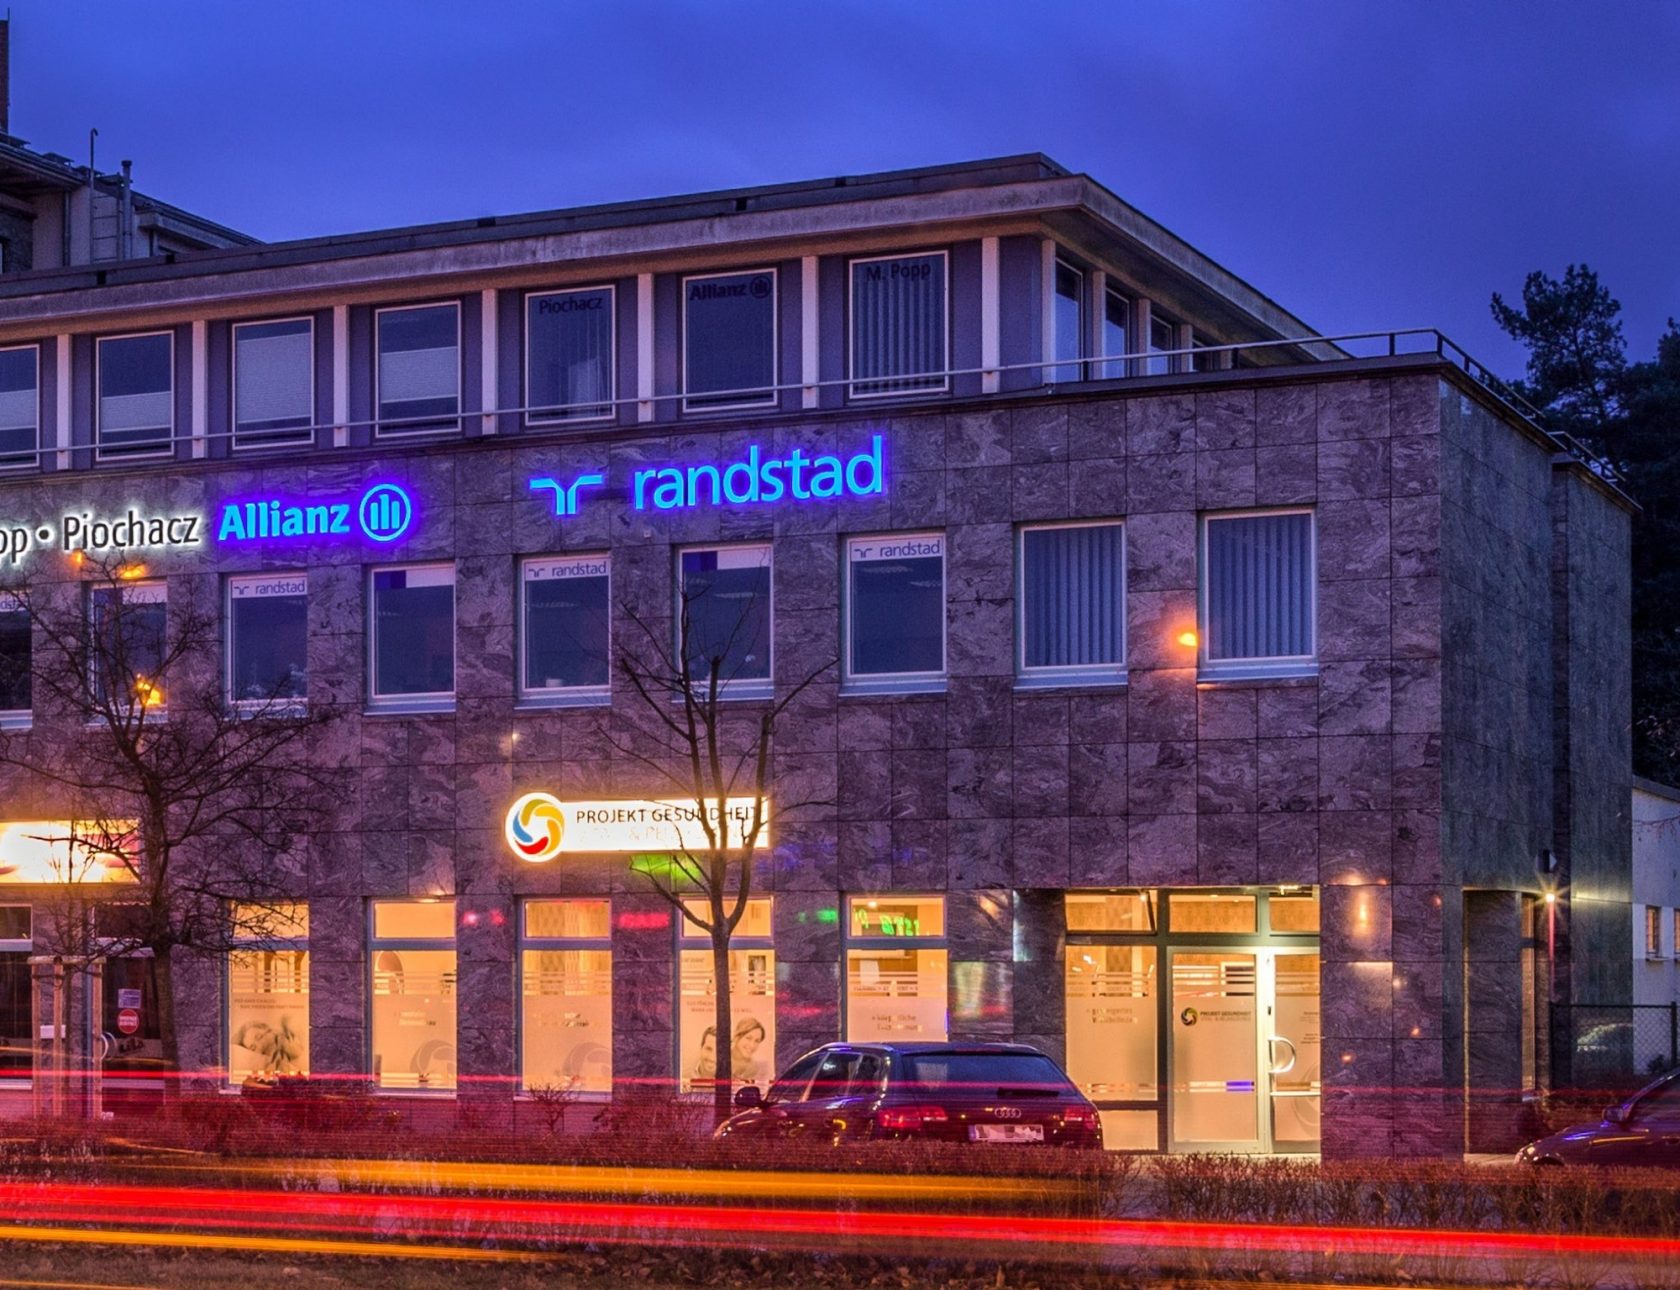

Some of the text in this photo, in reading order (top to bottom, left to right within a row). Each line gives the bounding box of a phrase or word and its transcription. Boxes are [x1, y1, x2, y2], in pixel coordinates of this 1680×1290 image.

[865, 261, 931, 282] M. Popp
[689, 280, 747, 301] Allianz
[539, 296, 604, 315] Piochacz
[634, 434, 882, 510] randstad
[63, 510, 200, 551] Piochacz
[218, 500, 351, 541] Allianz
[879, 540, 941, 558] randstad
[551, 561, 607, 577] randstad
[254, 580, 305, 595] randstad
[576, 808, 647, 824] PROJEKT
